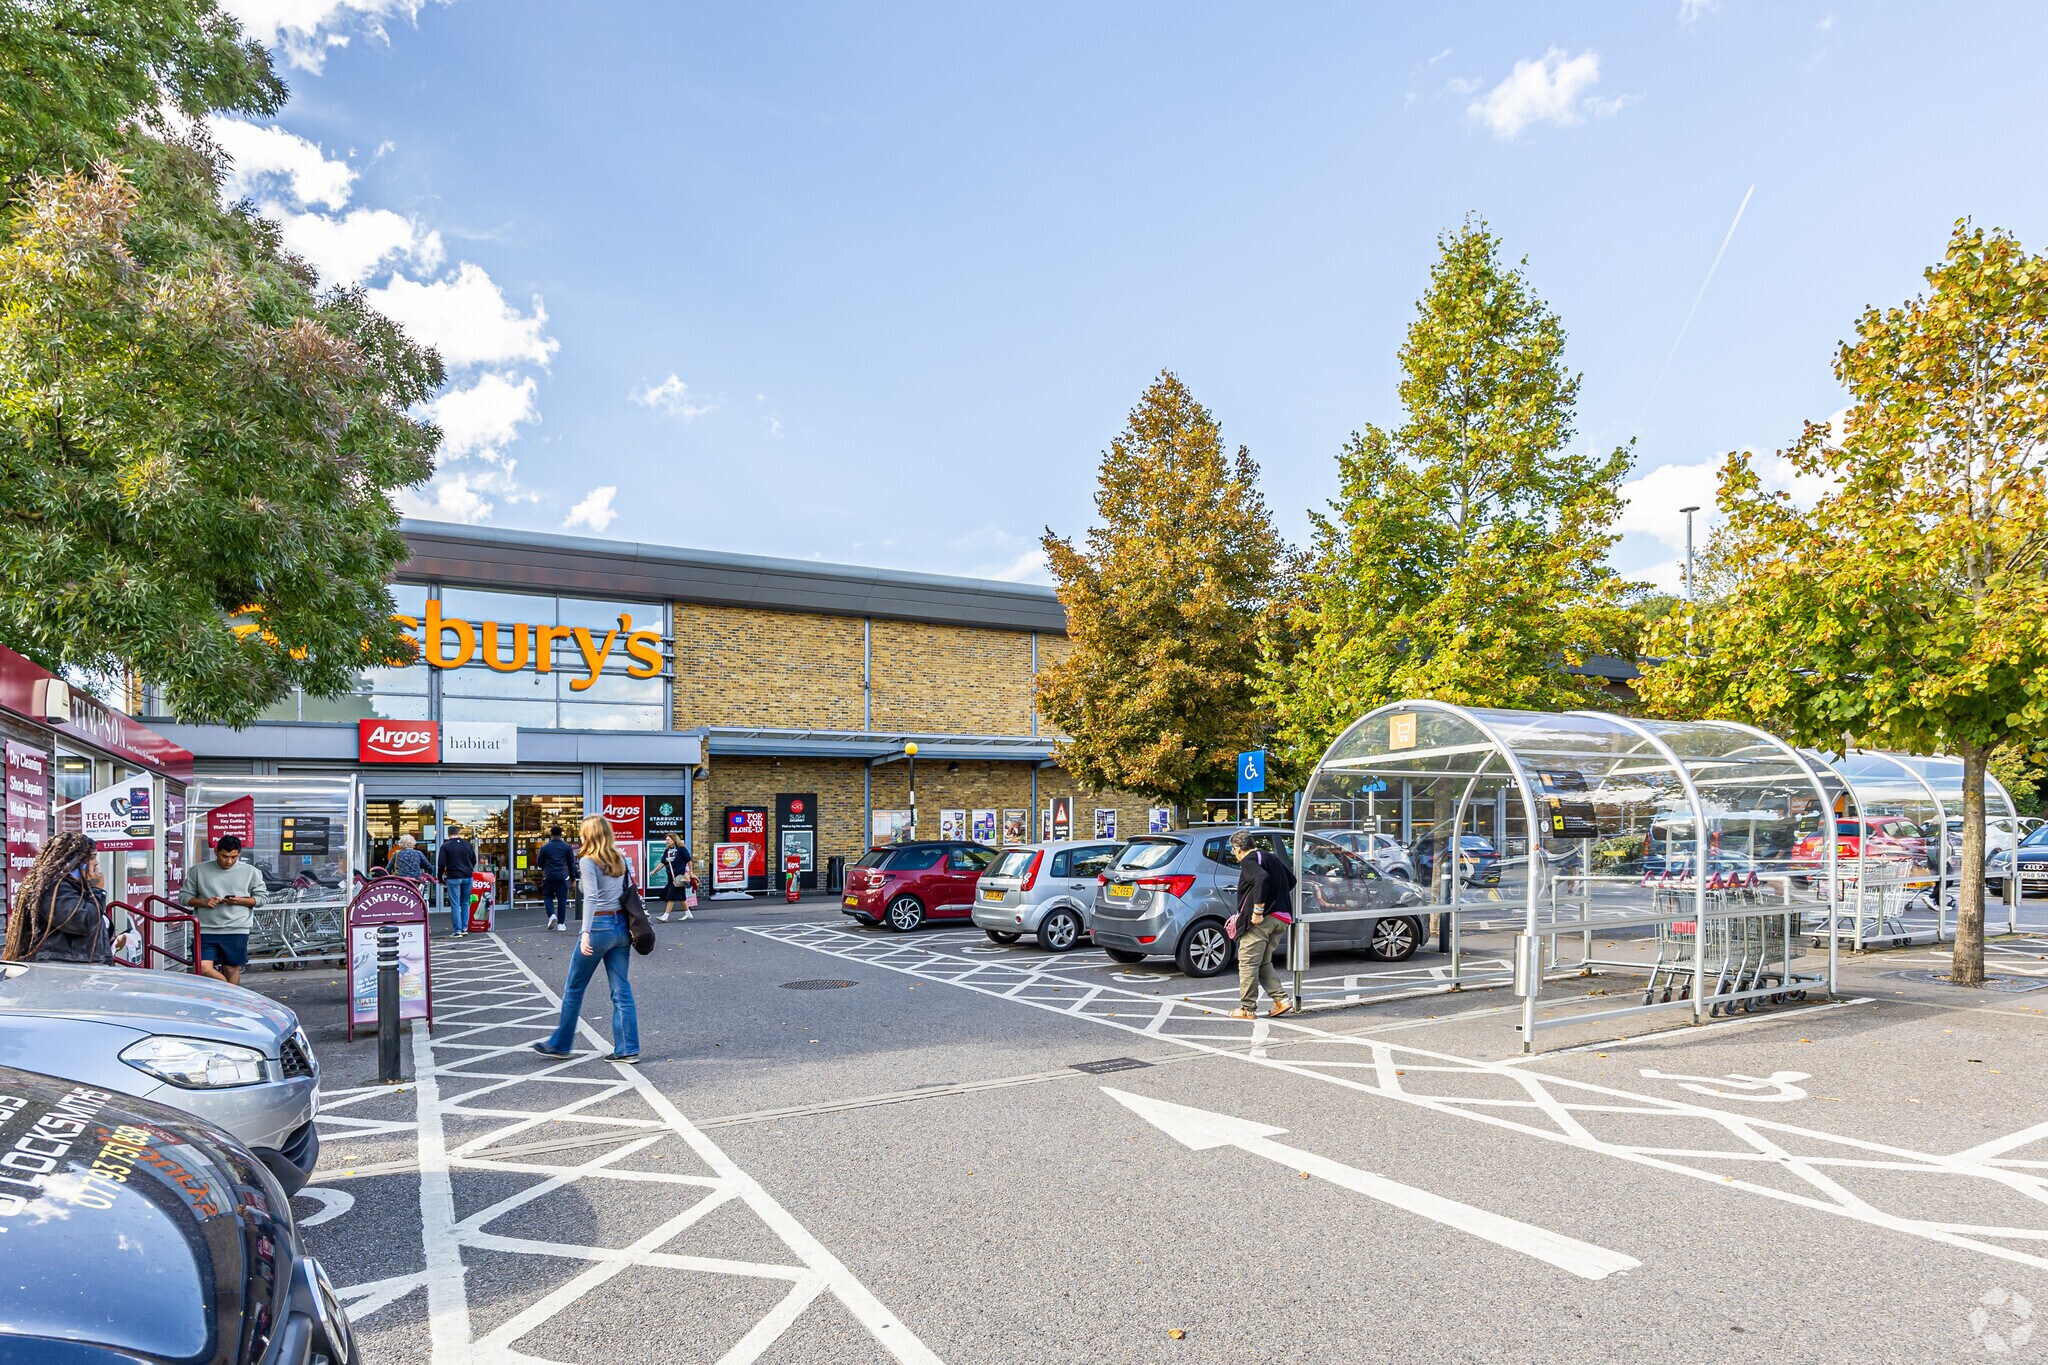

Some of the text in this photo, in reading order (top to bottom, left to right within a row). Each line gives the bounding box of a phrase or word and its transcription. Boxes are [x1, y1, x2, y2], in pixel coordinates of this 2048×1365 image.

[73, 696, 126, 748] TIMPSON
[368, 726, 432, 749] Argos
[450, 736, 500, 750] habitat
[10, 750, 42, 775] Dry Cleaning
[10, 776, 43, 797] Shoe Repairs
[10, 801, 46, 822] Watch Repairs
[86, 812, 110, 820] TECH
[602, 804, 640, 818] Argos
[86, 820, 128, 828] REPAIRS
[10, 827, 40, 846] Key Cutting
[358, 893, 418, 911] TIMPSON
[364, 932, 378, 940] Ca
[0, 1086, 113, 1188] LOCKSMITHS
